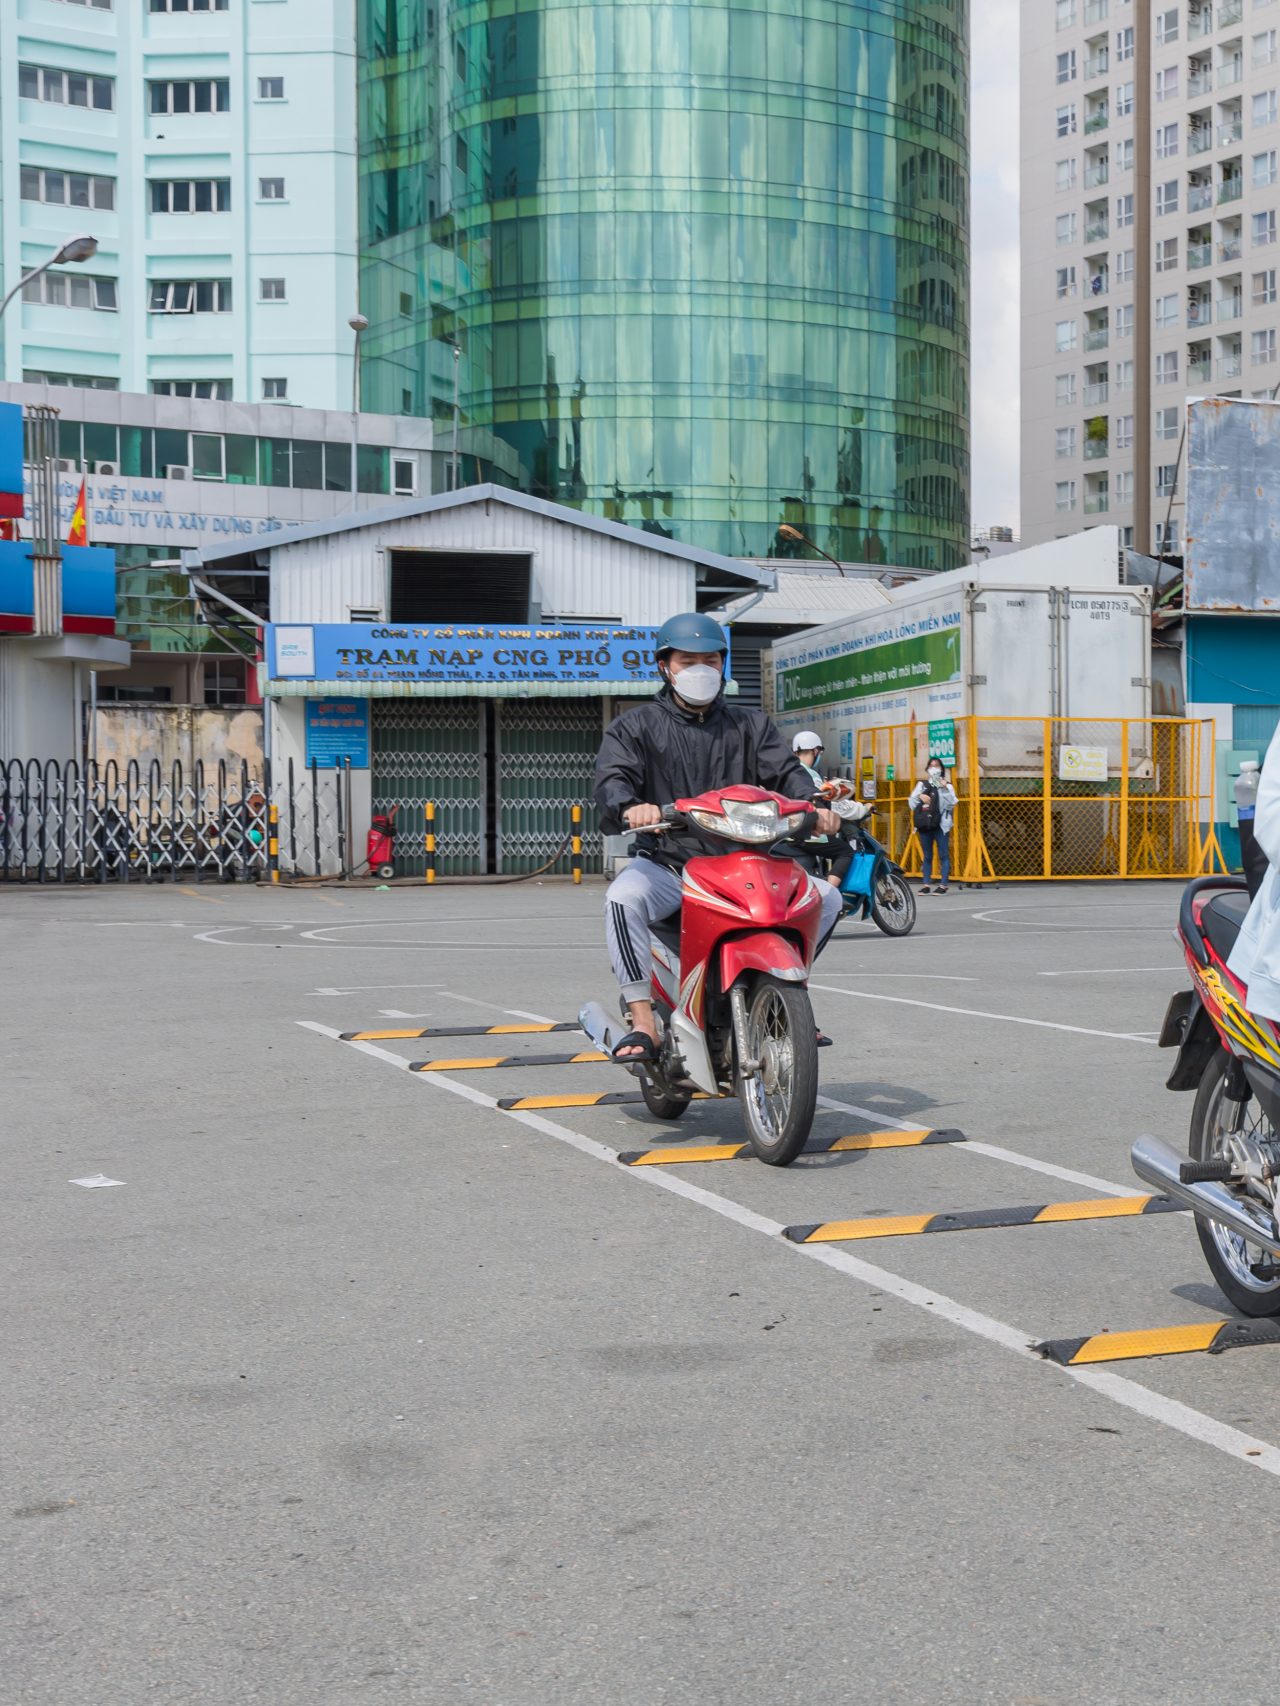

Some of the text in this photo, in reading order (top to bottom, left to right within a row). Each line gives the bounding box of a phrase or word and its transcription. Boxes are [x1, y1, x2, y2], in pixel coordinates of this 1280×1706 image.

[98, 484, 127, 504] VIỆT
[131, 489, 163, 503] NAM
[129, 511, 150, 528] TƯ
[154, 510, 174, 529] VÀ
[178, 512, 208, 531] XÂY
[212, 515, 253, 535] DỰNG
[942, 611, 961, 626] NAM
[371, 626, 408, 639] CÔNG
[412, 629, 428, 639] TY
[499, 630, 531, 640] KINH
[535, 630, 581, 640] DOANH
[336, 648, 419, 669] TRẠM
[428, 648, 483, 669] NẠP
[493, 649, 550, 666] CNG
[511, 669, 530, 679] TÂN
